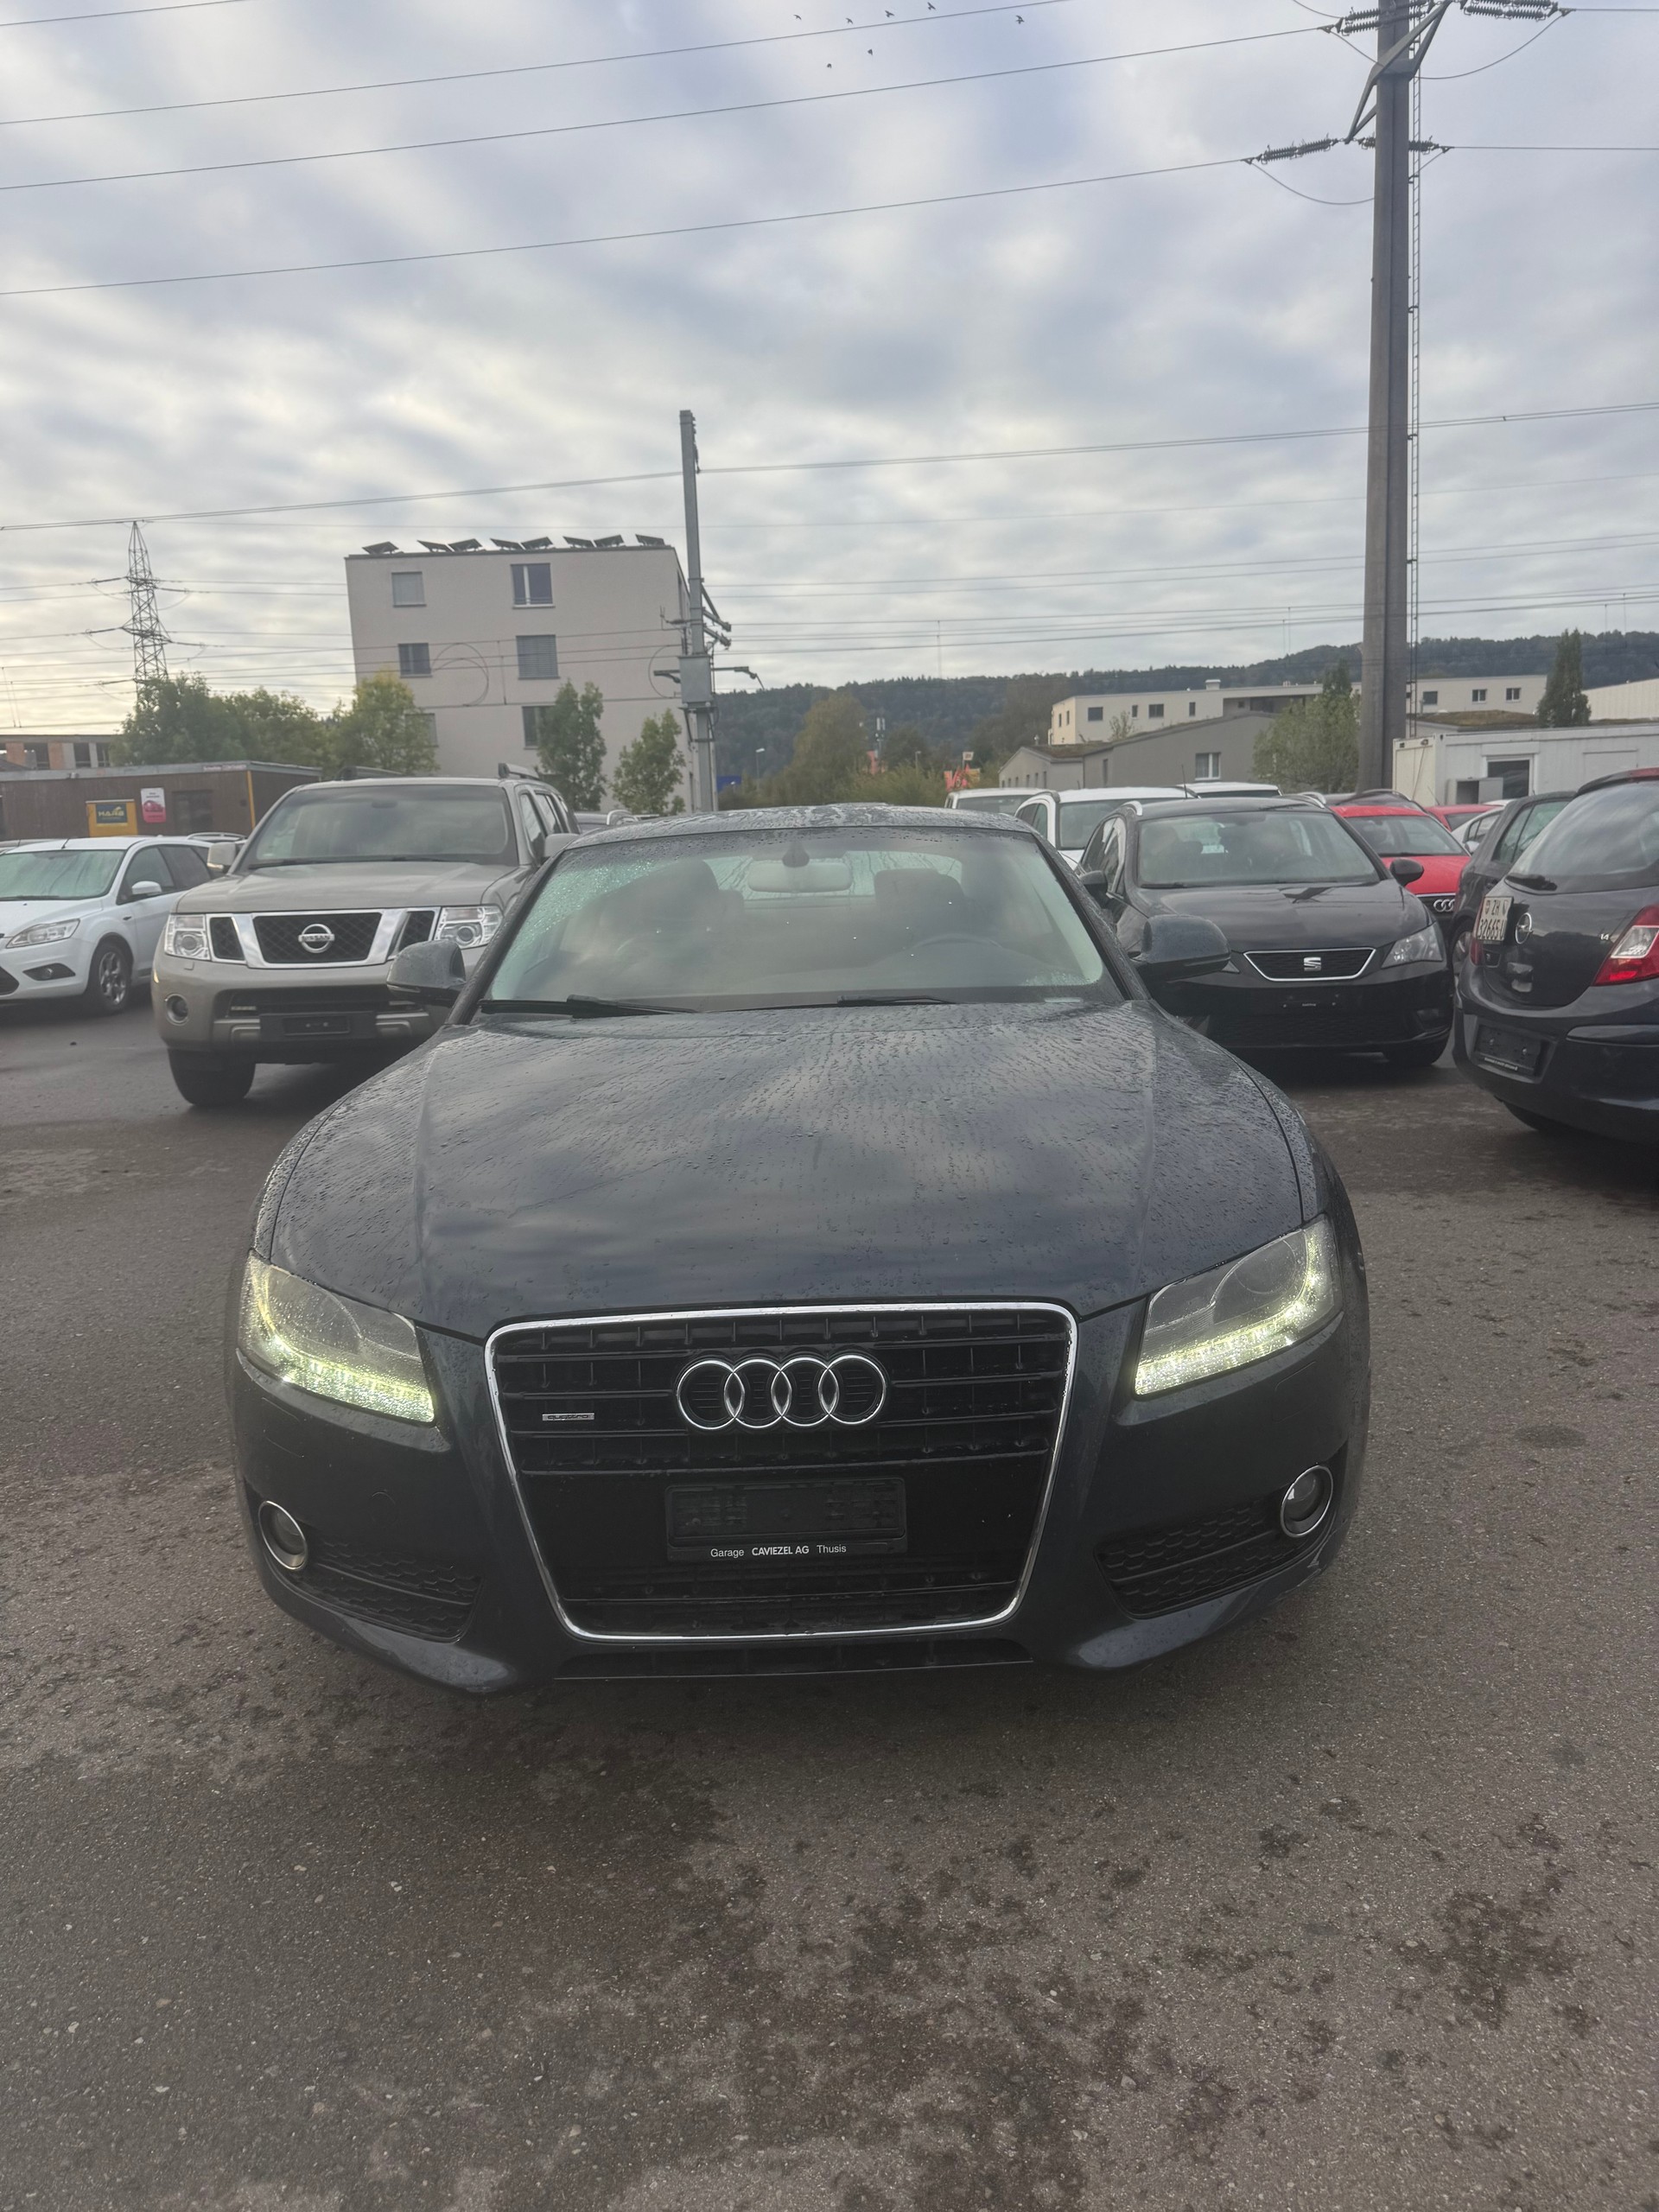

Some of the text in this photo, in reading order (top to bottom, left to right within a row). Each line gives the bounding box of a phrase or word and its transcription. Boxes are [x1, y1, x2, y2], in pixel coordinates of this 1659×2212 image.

[1491, 899, 1501, 916] ZH
[710, 1544, 847, 1559] Garage CAVIEZEL AG Thusis
